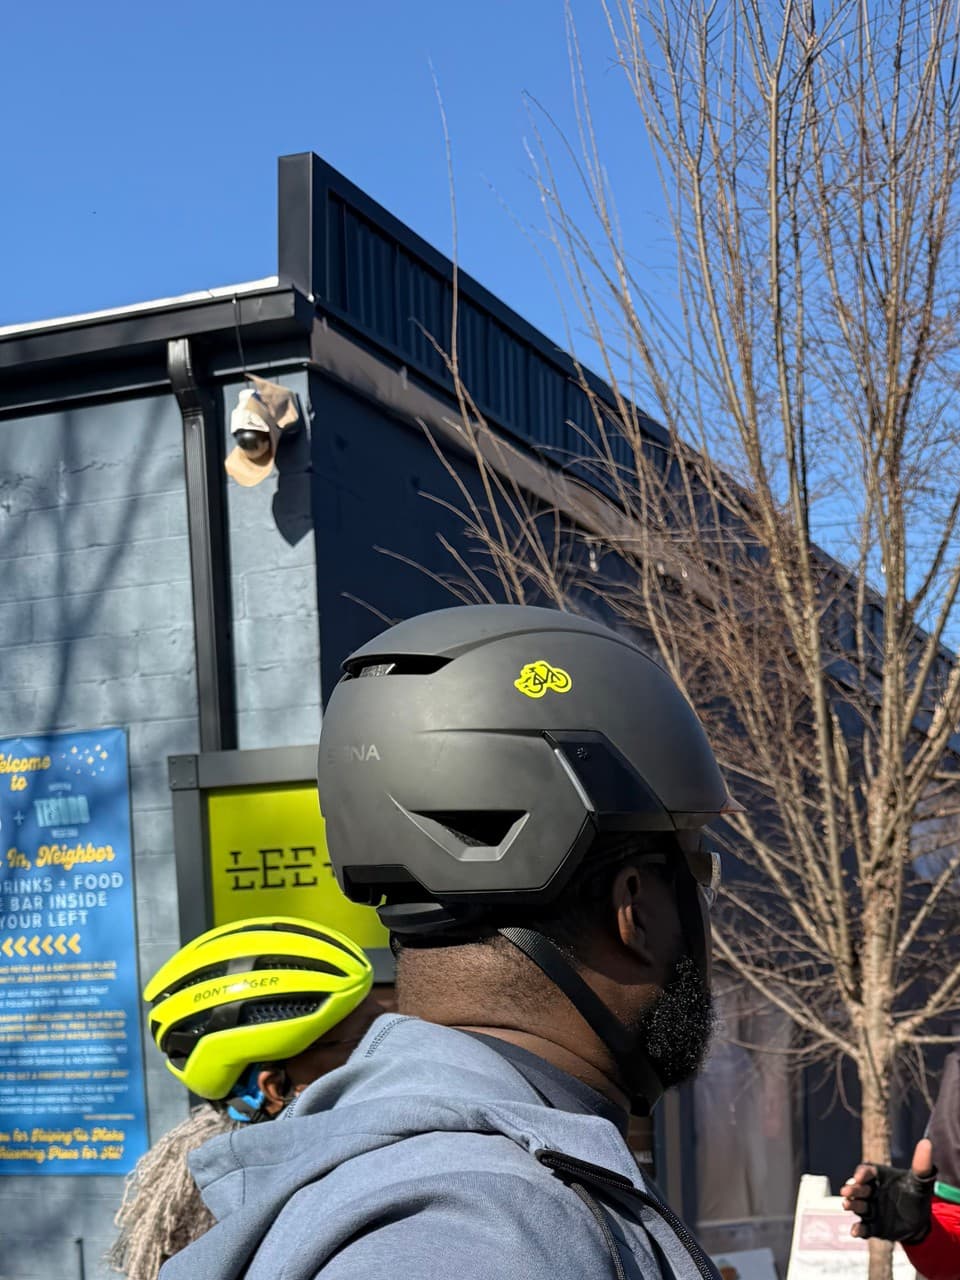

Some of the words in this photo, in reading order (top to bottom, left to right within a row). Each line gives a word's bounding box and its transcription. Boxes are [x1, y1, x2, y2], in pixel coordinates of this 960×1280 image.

[0, 753, 51, 773] elcome
[10, 774, 28, 791] to
[36, 843, 115, 870] Neighbor
[226, 847, 318, 891] LEE
[0, 877, 52, 894] RINKS
[73, 872, 123, 890] FOOD
[11, 894, 43, 911] BAR
[50, 891, 107, 909] INSIDE
[48, 910, 88, 927] LEFT
